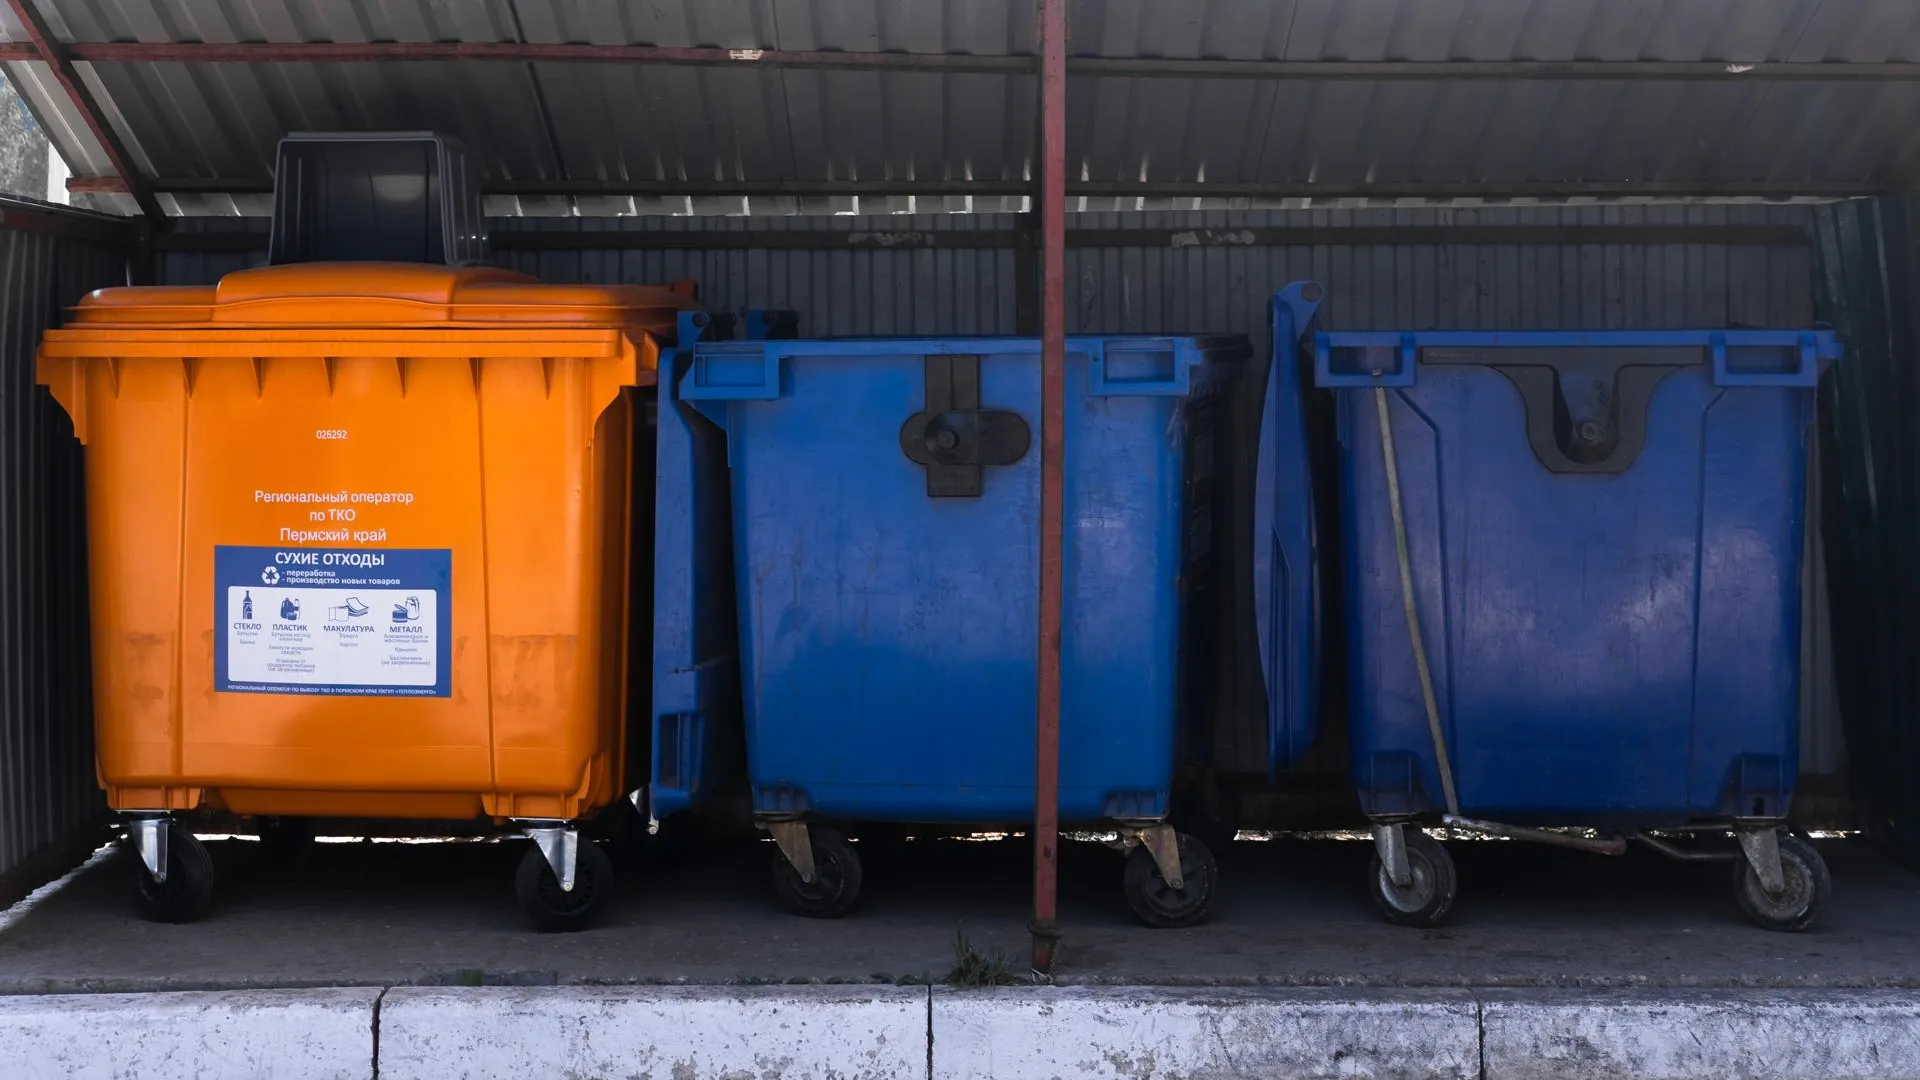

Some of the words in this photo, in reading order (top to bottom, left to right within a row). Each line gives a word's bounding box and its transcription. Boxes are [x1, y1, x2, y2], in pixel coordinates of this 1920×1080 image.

[316, 430, 347, 440] 026292
[255, 490, 348, 503] Региональный
[351, 492, 414, 505] оператор
[310, 511, 325, 521] по
[328, 509, 356, 521] ТКО
[280, 528, 349, 543] Пермский
[354, 529, 386, 542] край
[275, 552, 319, 565] СУХИЕ
[322, 553, 384, 568] ОТХОДЫ
[286, 570, 335, 578] переработка
[286, 577, 340, 586] производство
